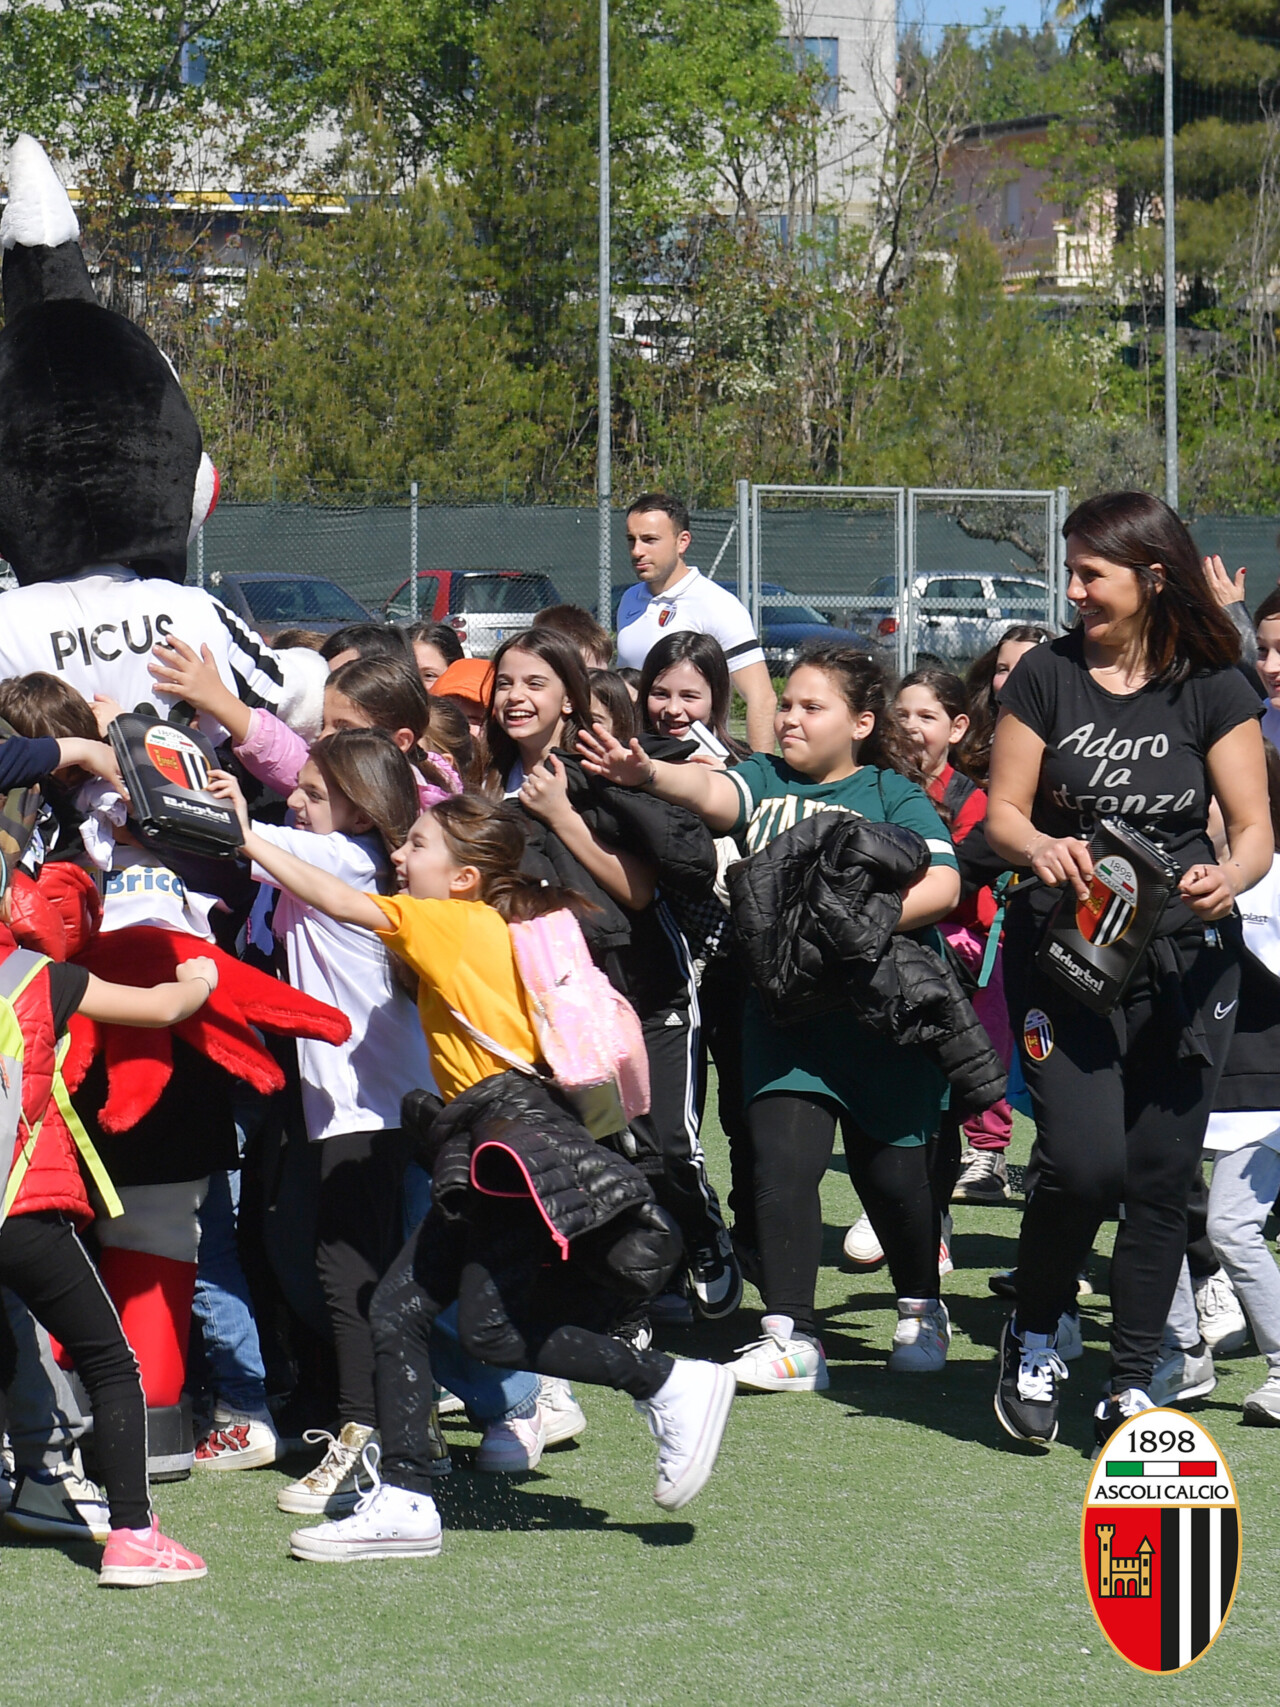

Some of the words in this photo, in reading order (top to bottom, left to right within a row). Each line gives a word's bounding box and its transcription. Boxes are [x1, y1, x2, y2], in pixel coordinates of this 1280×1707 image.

[50, 614, 174, 671] PICUS
[1056, 722, 1169, 760] Adoro
[1088, 758, 1132, 788] la
[1109, 859, 1132, 882] 1898
[1060, 952, 1105, 991] digital
